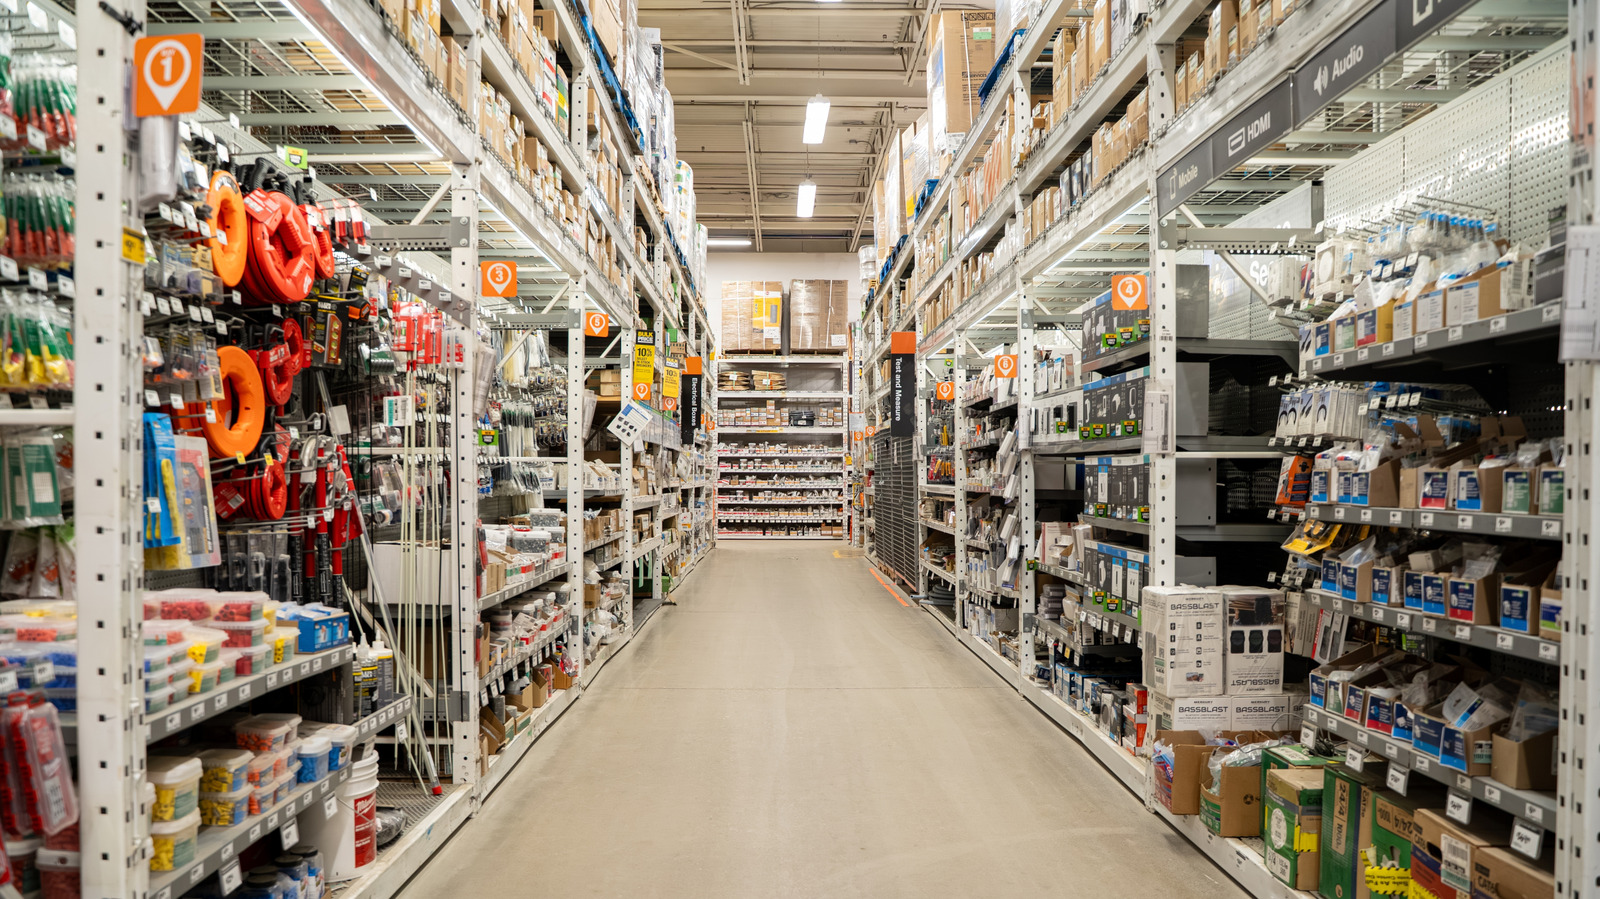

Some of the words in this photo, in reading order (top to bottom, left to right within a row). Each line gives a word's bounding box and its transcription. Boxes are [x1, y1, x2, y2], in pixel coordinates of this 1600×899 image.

[160, 56, 173, 81] 1
[1331, 45, 1364, 82] Audio
[1248, 111, 1271, 143] HDMI
[1178, 165, 1198, 188] Mobile
[495, 271, 504, 282] 3
[1125, 284, 1134, 295] 4
[1002, 360, 1008, 368] 6
[1336, 782, 1347, 816] 24/4
